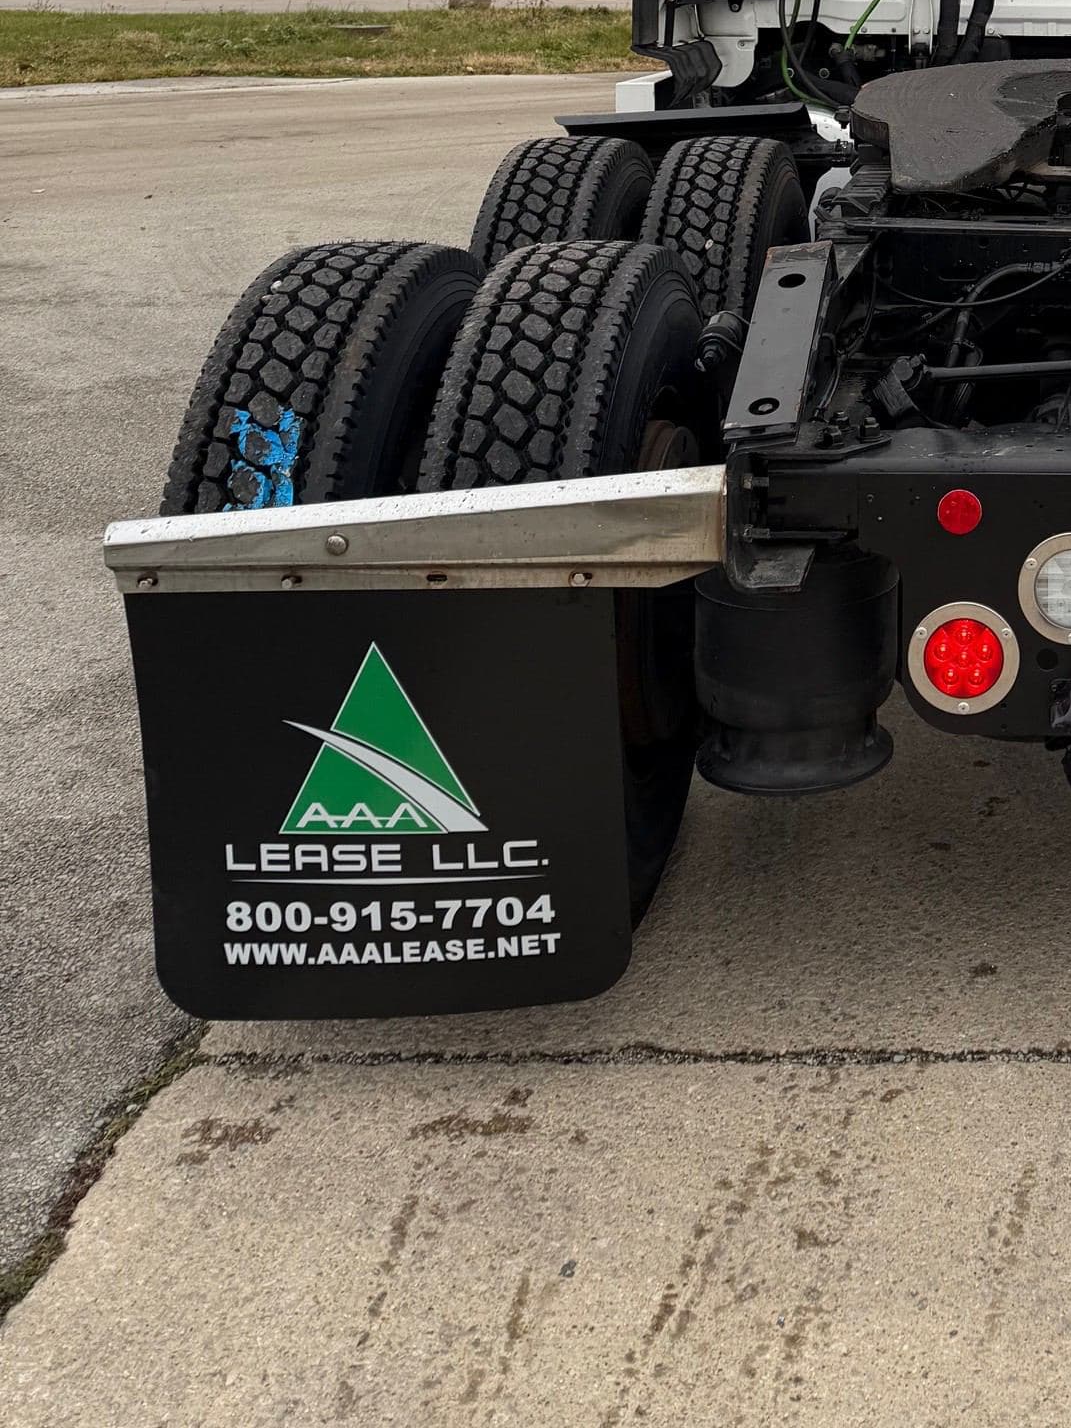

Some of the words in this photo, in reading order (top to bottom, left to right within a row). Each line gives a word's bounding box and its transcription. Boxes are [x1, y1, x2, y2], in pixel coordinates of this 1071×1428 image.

[295, 802, 428, 829] AAA
[225, 843, 402, 872] LEASE
[432, 840, 549, 870] LLC.
[226, 894, 556, 932] 800-915-7704
[223, 932, 561, 965] WWW.AAALEASE.NET
